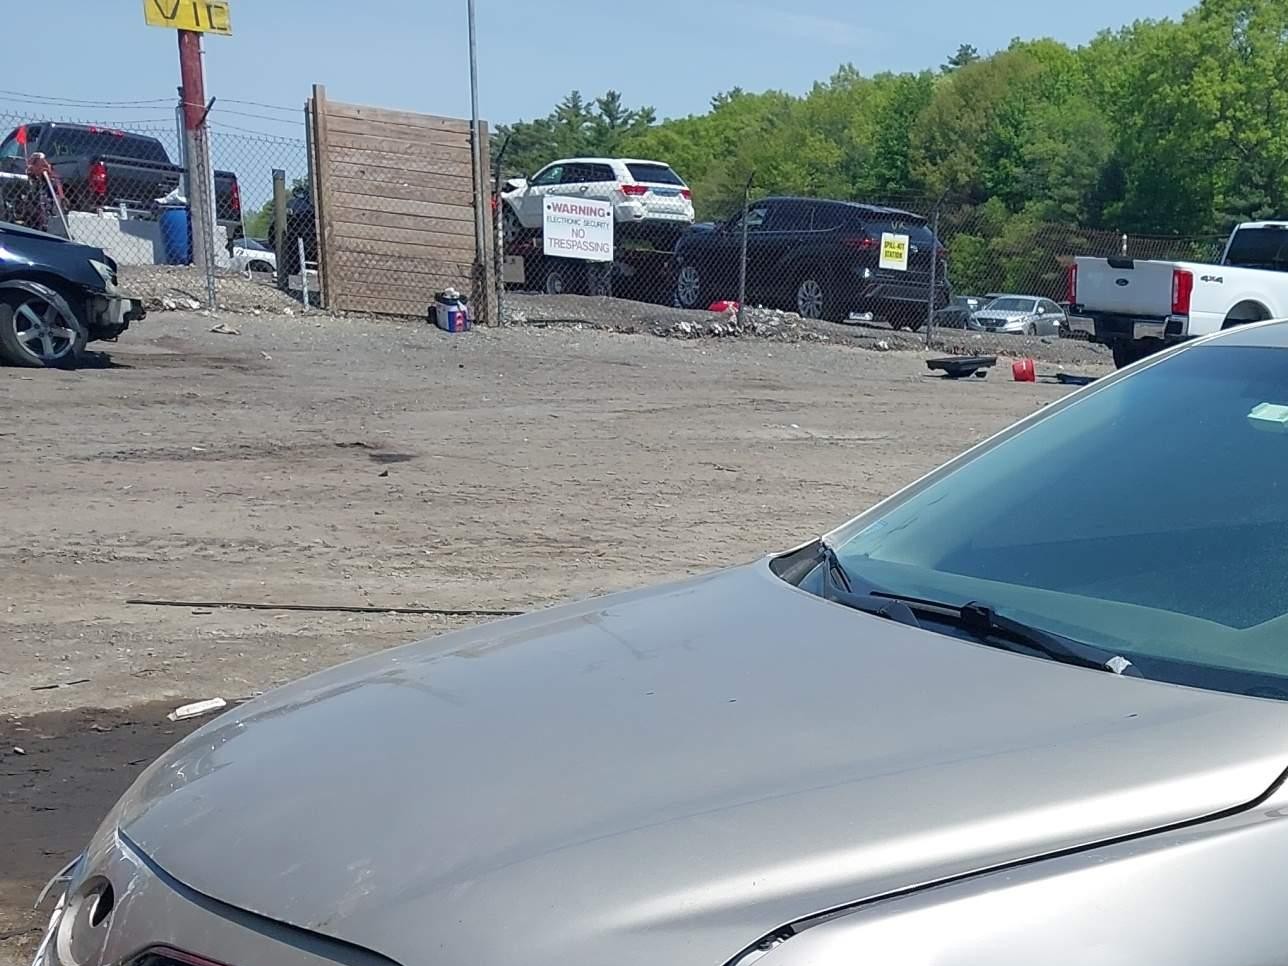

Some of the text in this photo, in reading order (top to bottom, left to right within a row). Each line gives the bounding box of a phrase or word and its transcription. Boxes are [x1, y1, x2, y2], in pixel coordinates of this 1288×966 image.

[551, 202, 606, 217] WARNING
[546, 215, 581, 226] ELECTRONIC
[571, 228, 586, 239] NO
[548, 237, 610, 253] TRESPASSING
